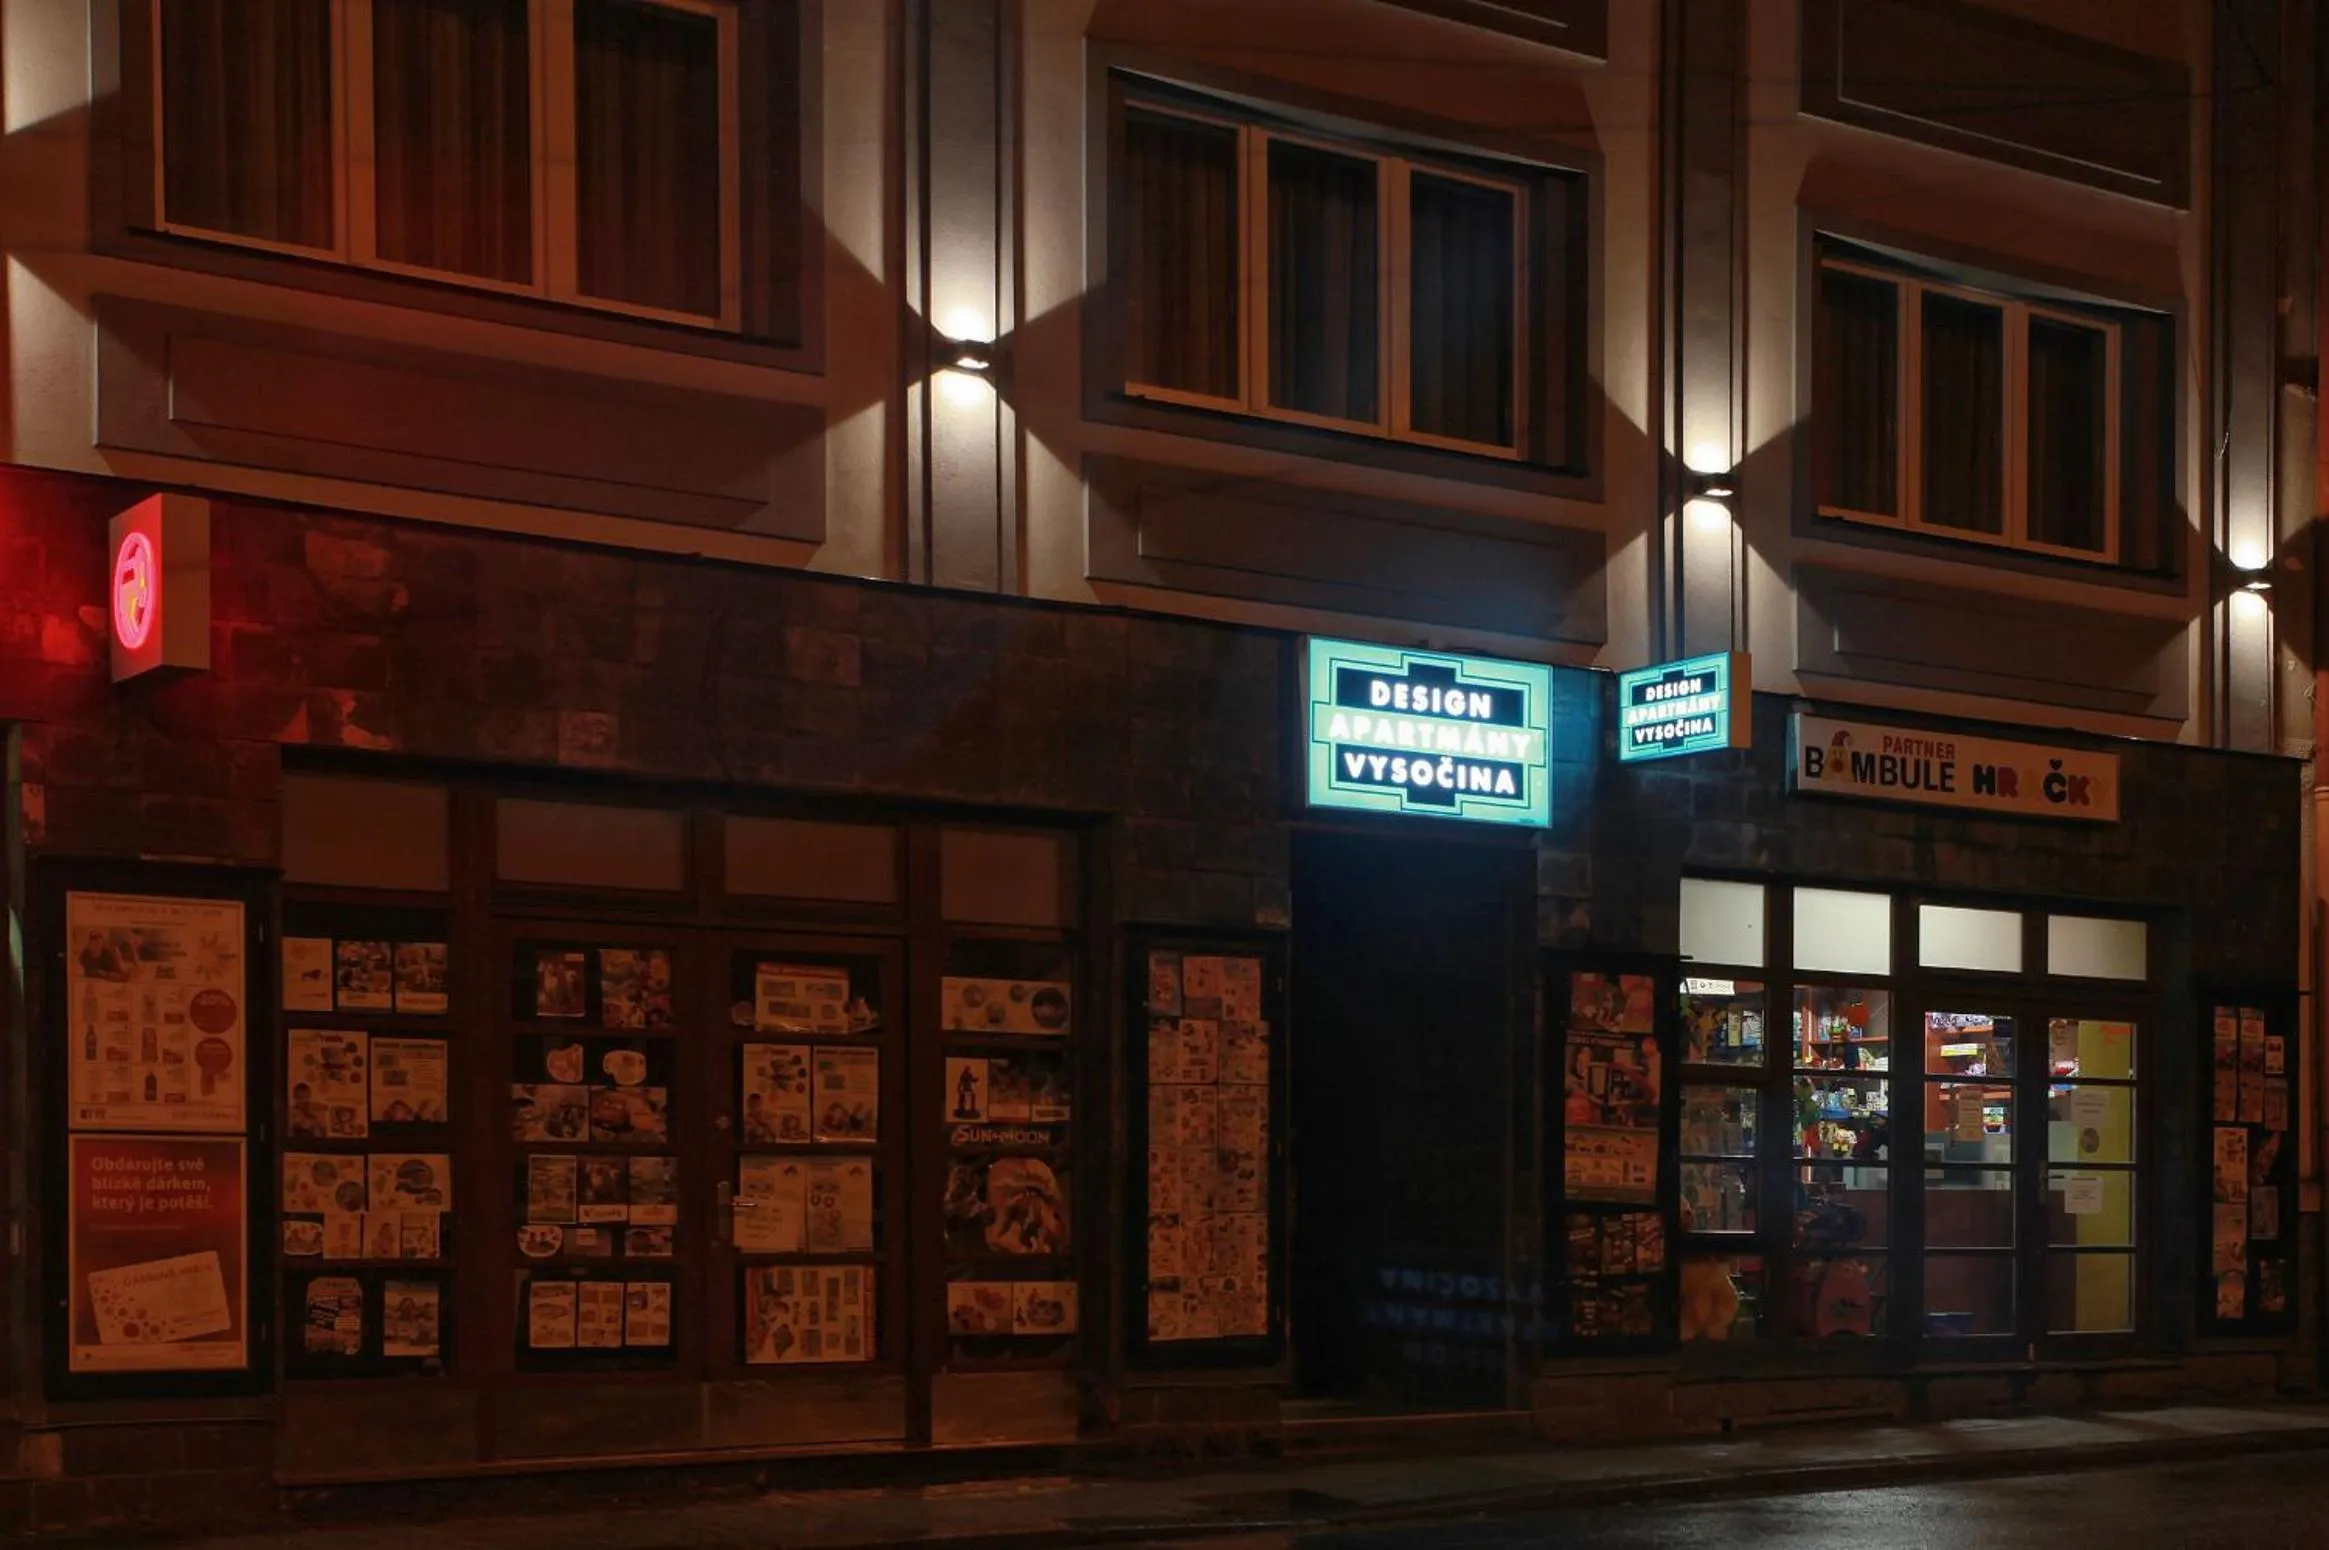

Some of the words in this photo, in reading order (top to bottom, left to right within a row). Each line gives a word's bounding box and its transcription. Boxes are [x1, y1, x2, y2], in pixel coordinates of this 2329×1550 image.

[1369, 679, 1492, 718] DESIGN
[1645, 678, 1702, 701] DESIGN
[1627, 695, 1721, 725] APARTMÁNY
[1328, 711, 1533, 758] APARTMÁNY
[1634, 717, 1714, 743] VYSOČINA
[1805, 732, 1956, 793] BAMBULE
[1882, 735, 1956, 760] PARTNER
[1343, 752, 1516, 795] VYSOČINA
